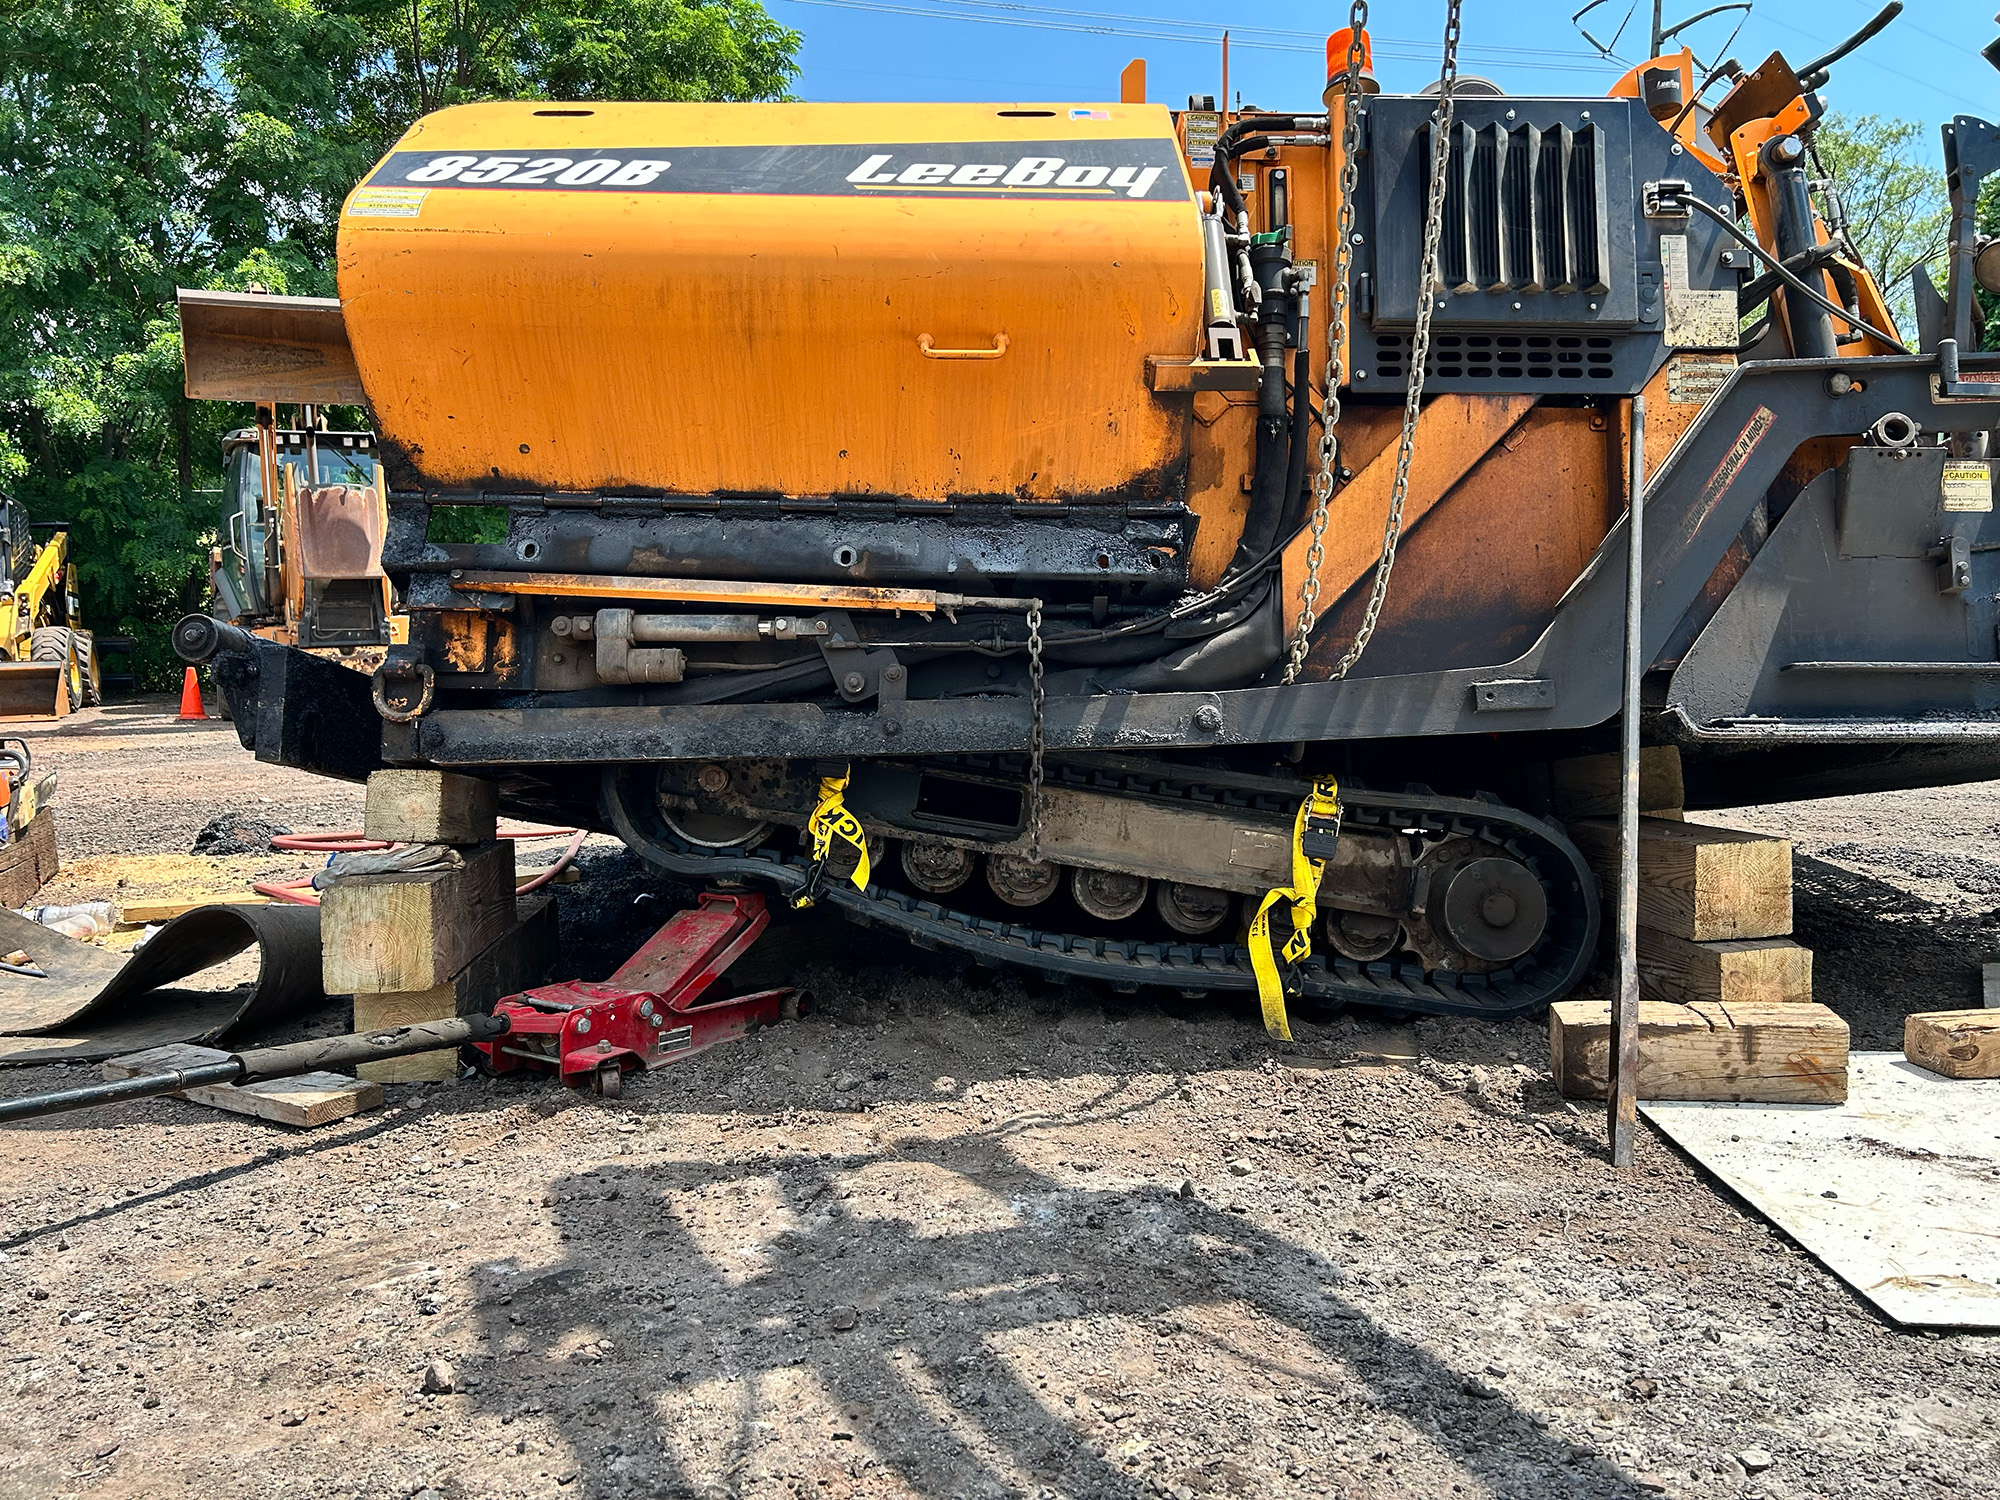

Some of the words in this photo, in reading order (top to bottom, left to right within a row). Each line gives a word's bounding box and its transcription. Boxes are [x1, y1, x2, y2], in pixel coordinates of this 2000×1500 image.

[406, 155, 672, 186] 8520B
[845, 154, 1164, 198] LeeBoy
[1702, 449, 1743, 505] PROFESSIONAL
